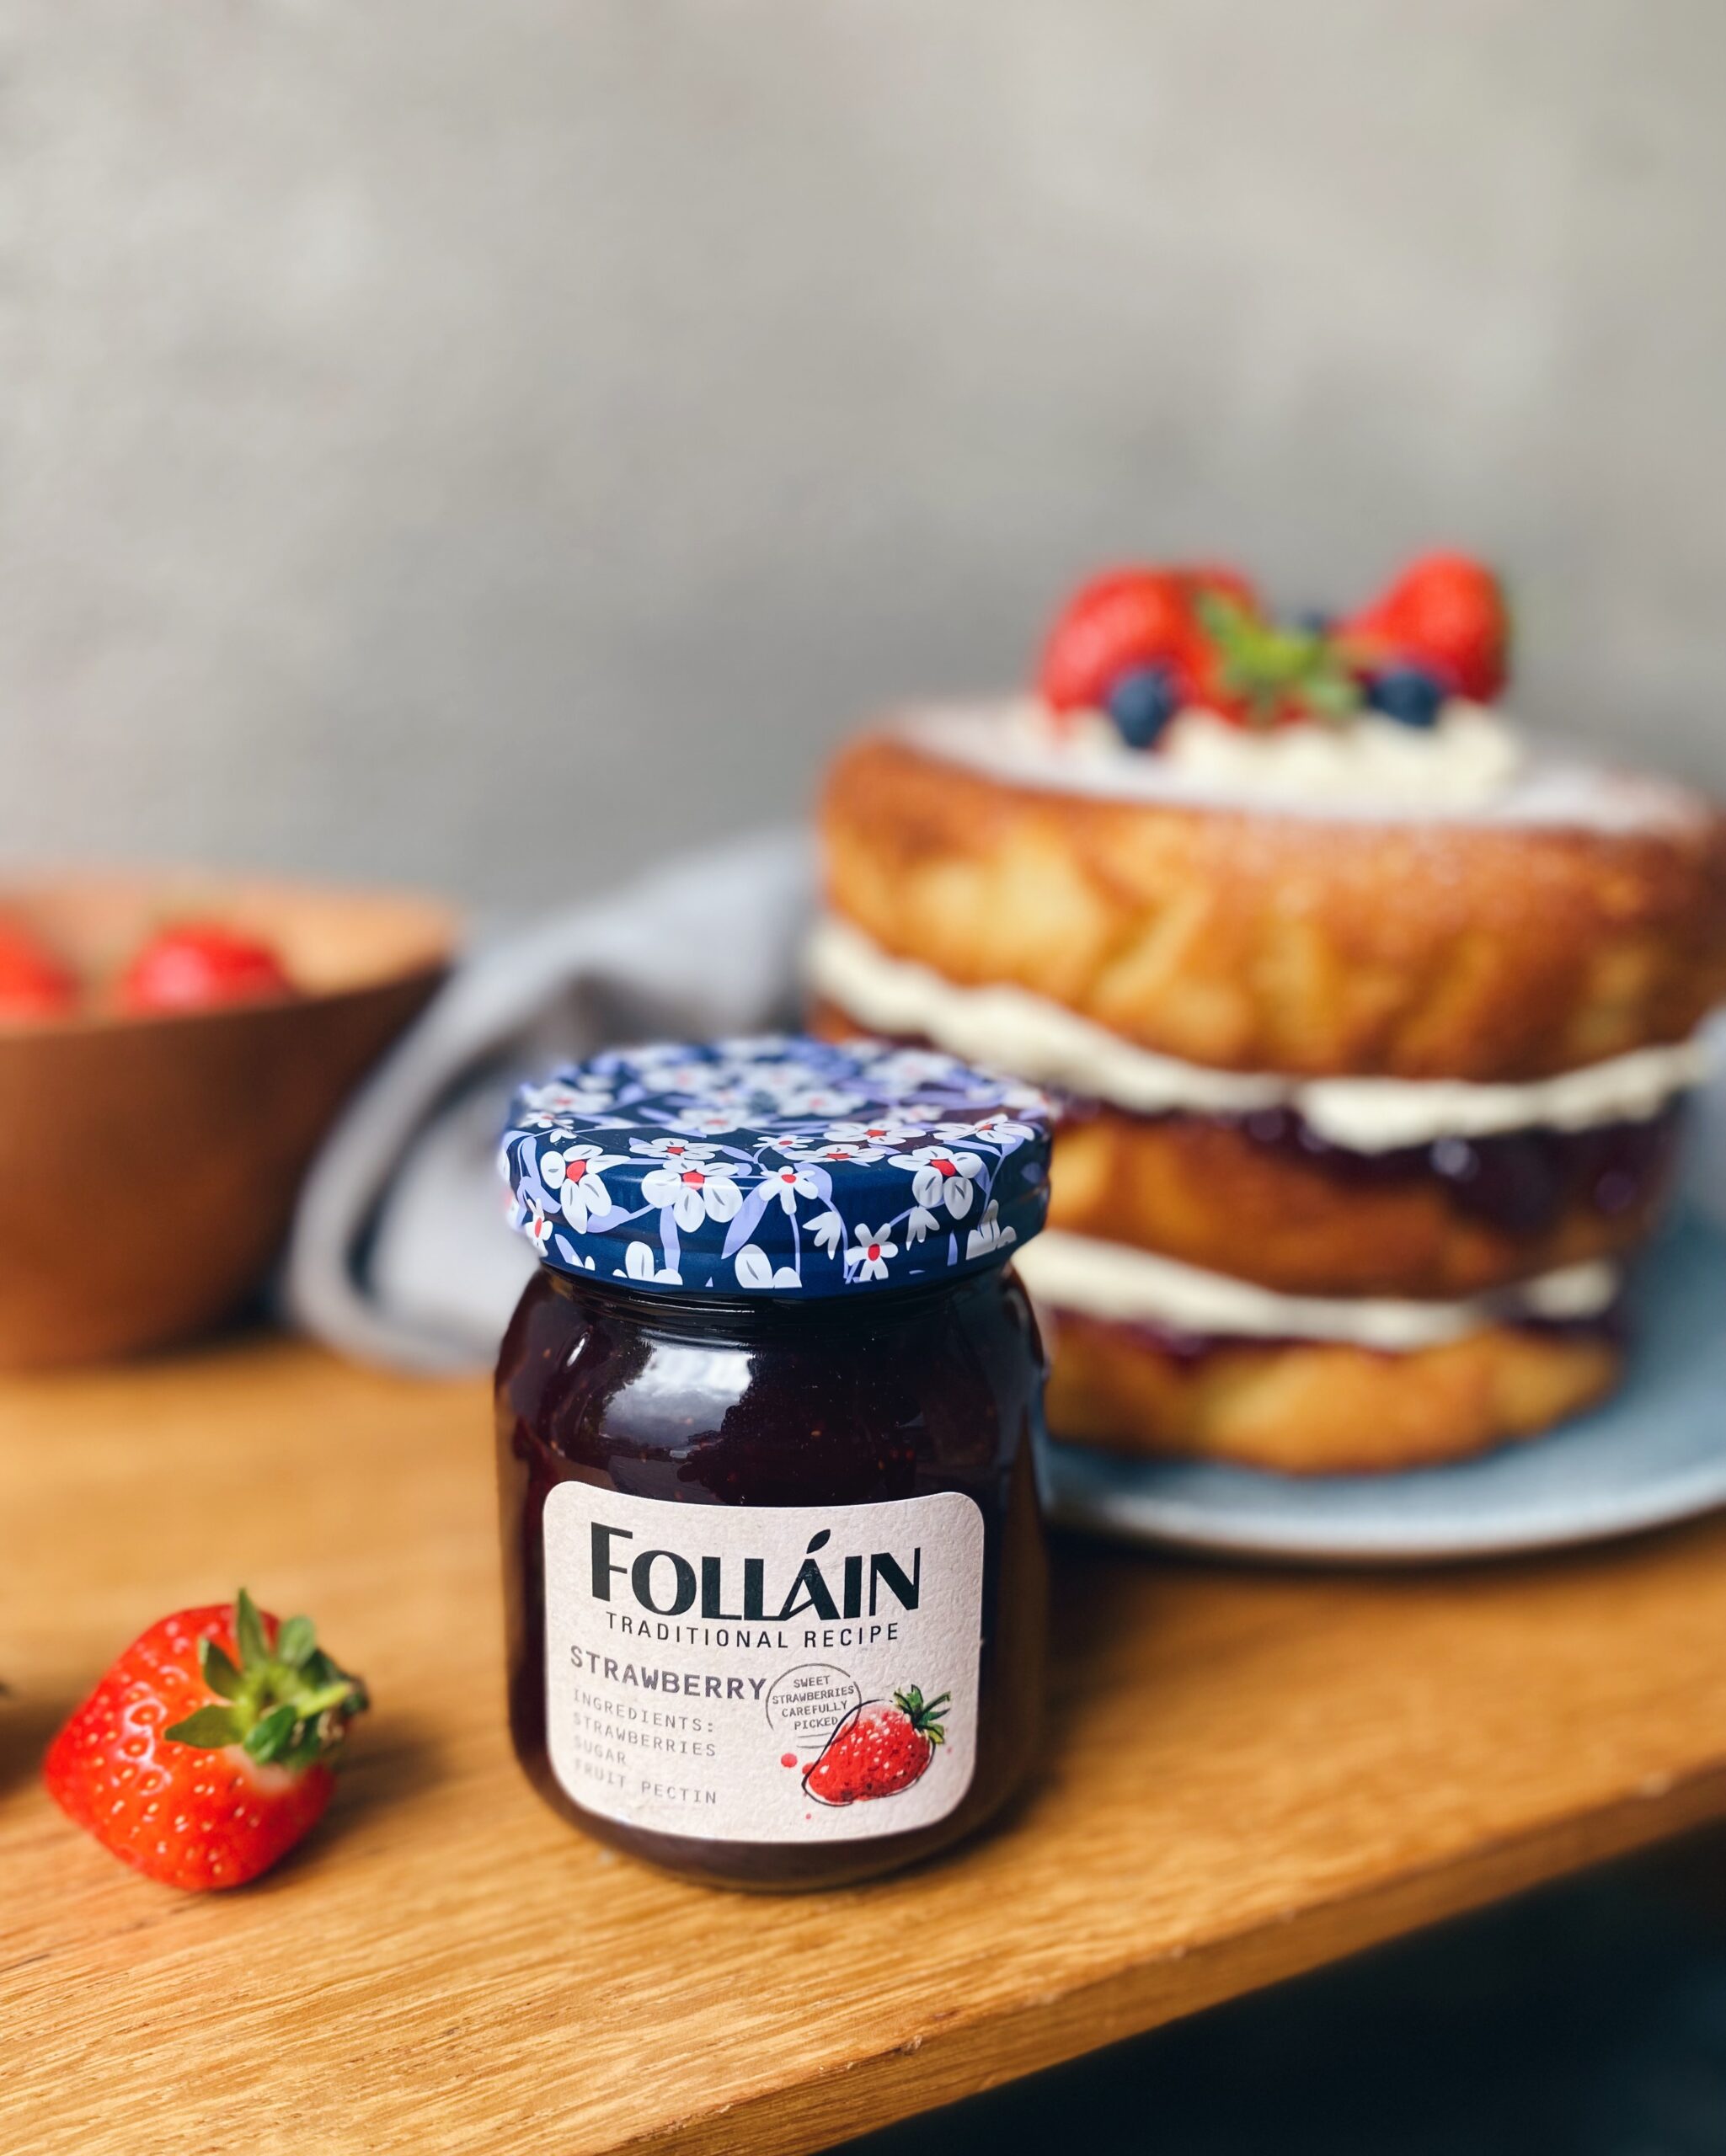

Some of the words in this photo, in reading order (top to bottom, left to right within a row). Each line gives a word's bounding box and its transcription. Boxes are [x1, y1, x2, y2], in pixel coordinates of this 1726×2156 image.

[607, 1611, 788, 1648] TRADITIONAL
[804, 1622, 899, 1648] RECIPE
[570, 1645, 767, 1700] STRAWBERRY
[794, 1675, 831, 1688] SWEET
[772, 1685, 854, 1704] STRAWBERRIES
[574, 1689, 714, 1732] INGREDIENTS:
[782, 1700, 847, 1717] CAREFULLY
[573, 1712, 716, 1757] STRAWBERRIES
[794, 1717, 838, 1730] PICKED
[574, 1735, 627, 1765] SUGAR
[642, 1781, 716, 1804] PECTIN
